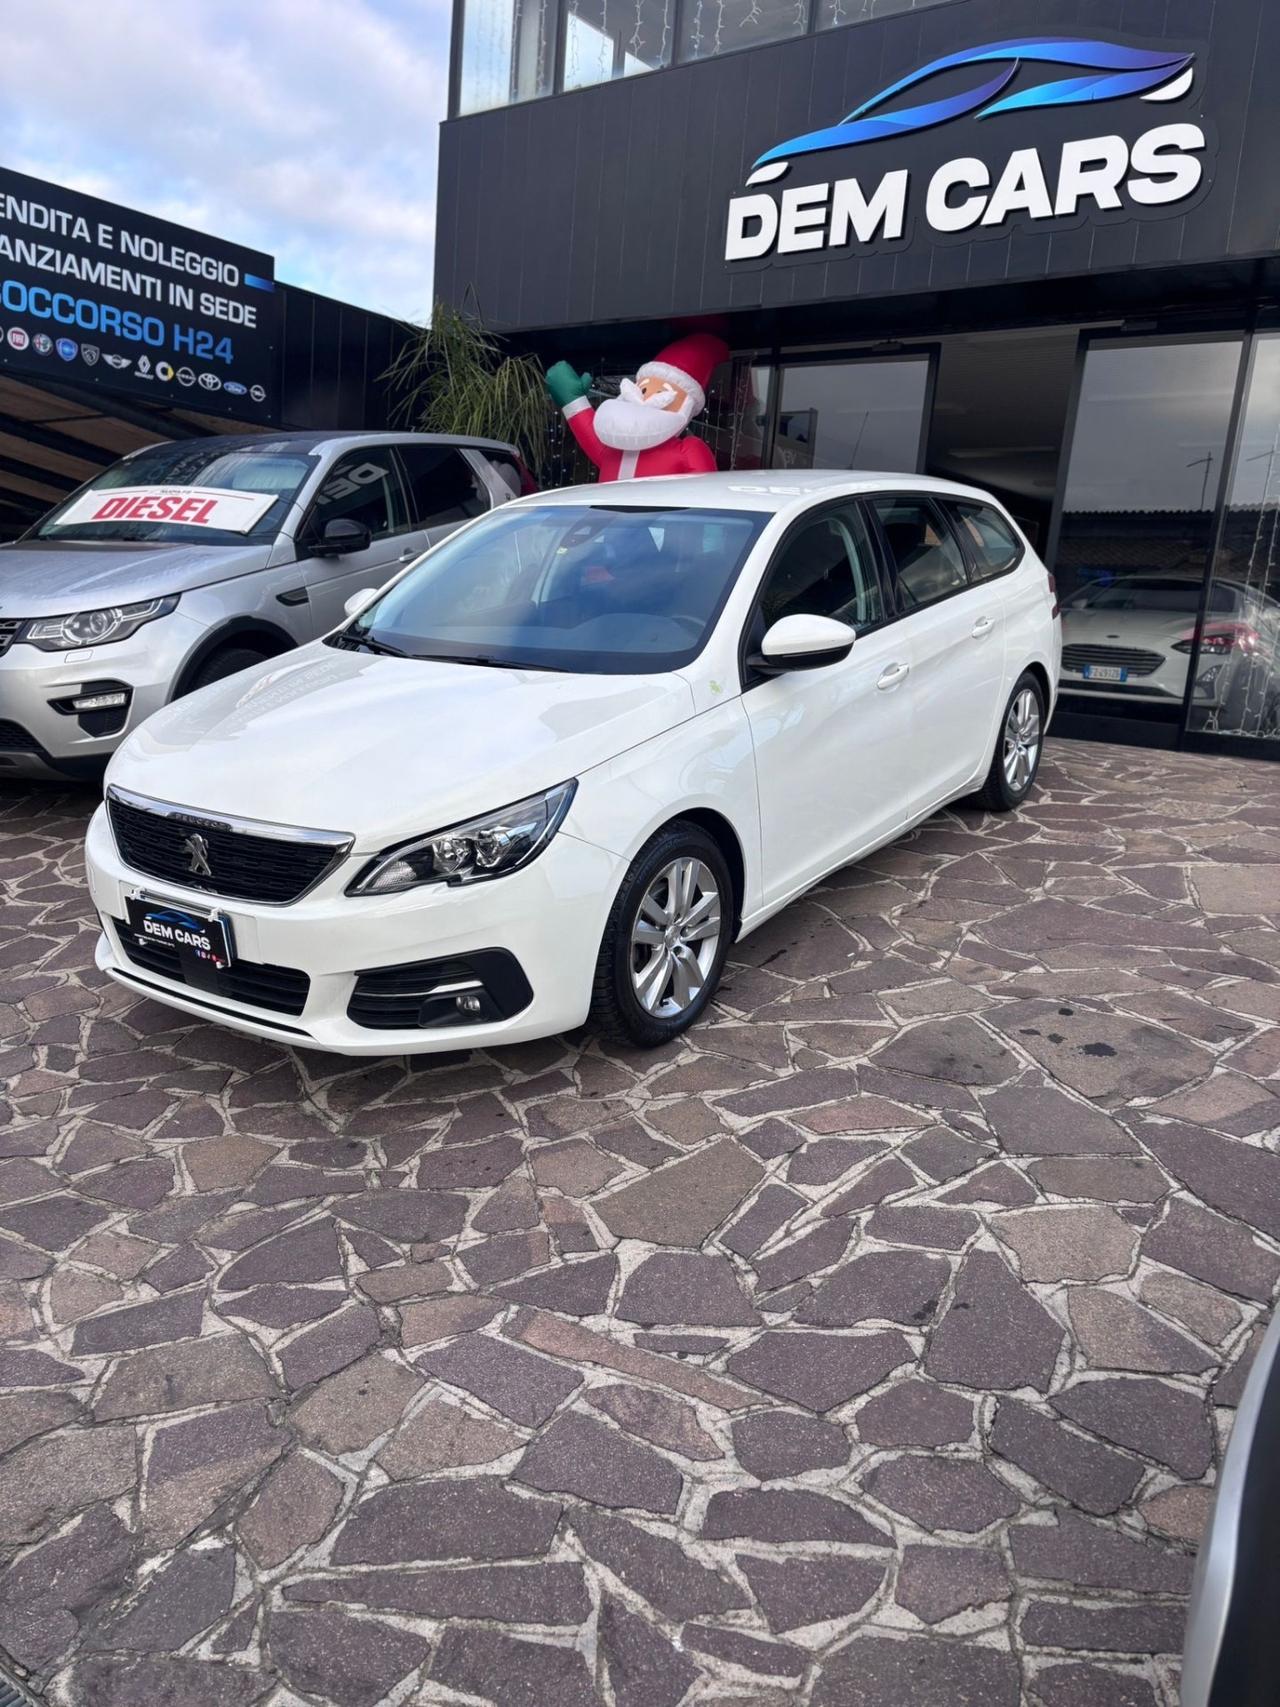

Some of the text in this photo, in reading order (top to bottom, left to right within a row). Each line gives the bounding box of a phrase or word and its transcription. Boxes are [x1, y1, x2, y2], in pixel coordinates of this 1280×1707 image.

[725, 123, 1205, 261] DEM CARS
[98, 223, 113, 249] E
[120, 231, 239, 287] NOLEGGIO
[0, 279, 234, 365] OCCORSO H24
[169, 283, 193, 311] IN
[200, 293, 257, 328] SEDE
[91, 496, 218, 524] DIESEL
[143, 920, 174, 940] DEM
[175, 929, 211, 950] CARS
